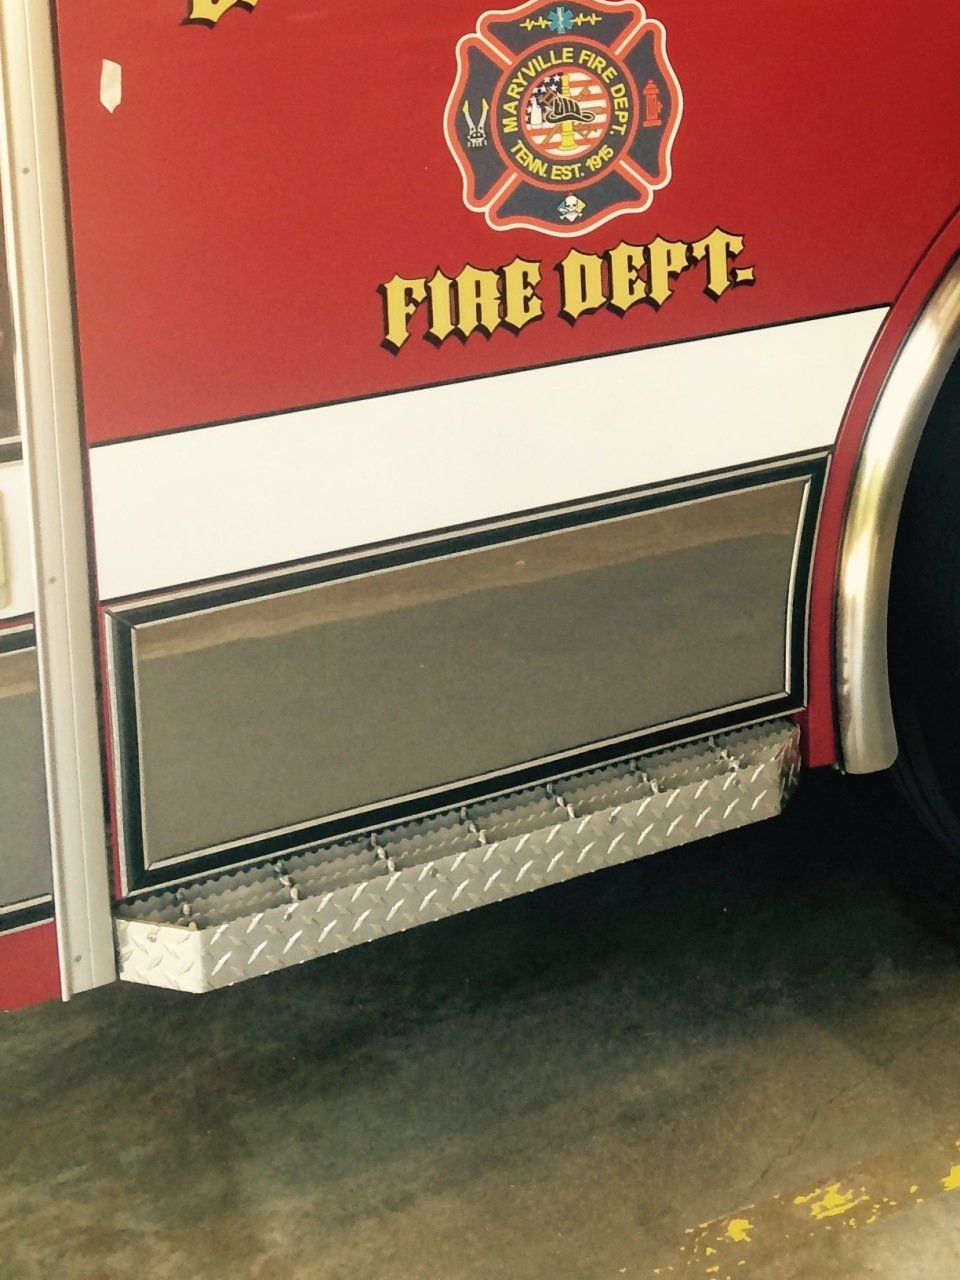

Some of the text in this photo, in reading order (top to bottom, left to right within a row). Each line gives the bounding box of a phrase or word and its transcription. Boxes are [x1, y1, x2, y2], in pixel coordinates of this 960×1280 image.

[503, 48, 629, 136] MARYVILLE FIRE DEPT.
[510, 140, 615, 181] TENN. EST. 1915
[378, 226, 756, 356] FIRE DEPT.
